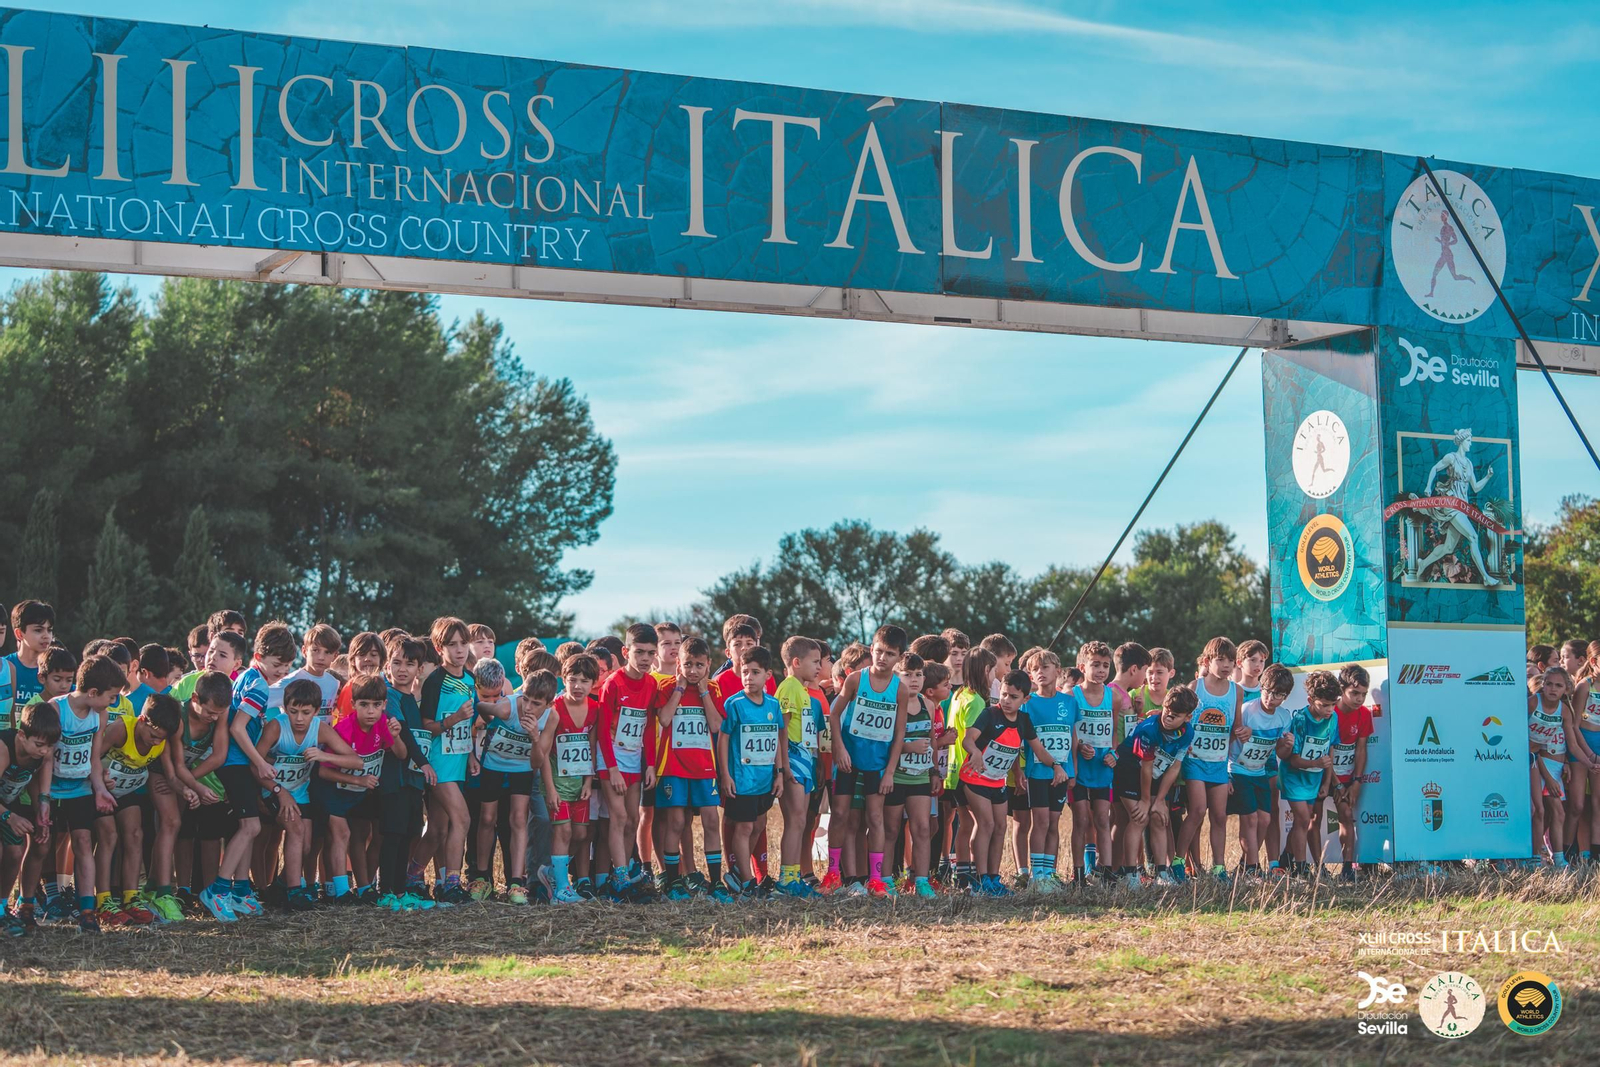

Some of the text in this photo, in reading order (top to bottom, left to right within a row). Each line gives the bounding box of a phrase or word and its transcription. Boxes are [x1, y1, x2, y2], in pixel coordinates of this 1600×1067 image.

[279, 75, 555, 164] CROSS
[280, 157, 655, 221] INTERNACIONAL
[679, 97, 1240, 280] ITÁLICA
[0, 190, 591, 262] NATIONAL CROSS COUNTRY
[1451, 354, 1499, 369] Diputación
[1452, 368, 1499, 388] Sevilla
[1385, 500, 1408, 518] CROSS
[1410, 498, 1458, 507] INTERNACIONAL
[1460, 502, 1470, 513] DE
[1315, 571, 1339, 579] ATHLETICS
[1318, 565, 1335, 573] WORLD
[856, 712, 892, 730] 4200
[677, 721, 708, 736] 4104
[1079, 722, 1110, 736] 4196
[745, 738, 776, 752] 4106
[1039, 737, 1070, 751] 4233
[1194, 737, 1226, 750] 4305
[53, 748, 89, 765] 4198
[1428, 747, 1455, 755] Andalucía
[1474, 748, 1513, 761] Andalucía
[1361, 811, 1389, 824] Osten
[1481, 809, 1509, 818] ITÁLICA
